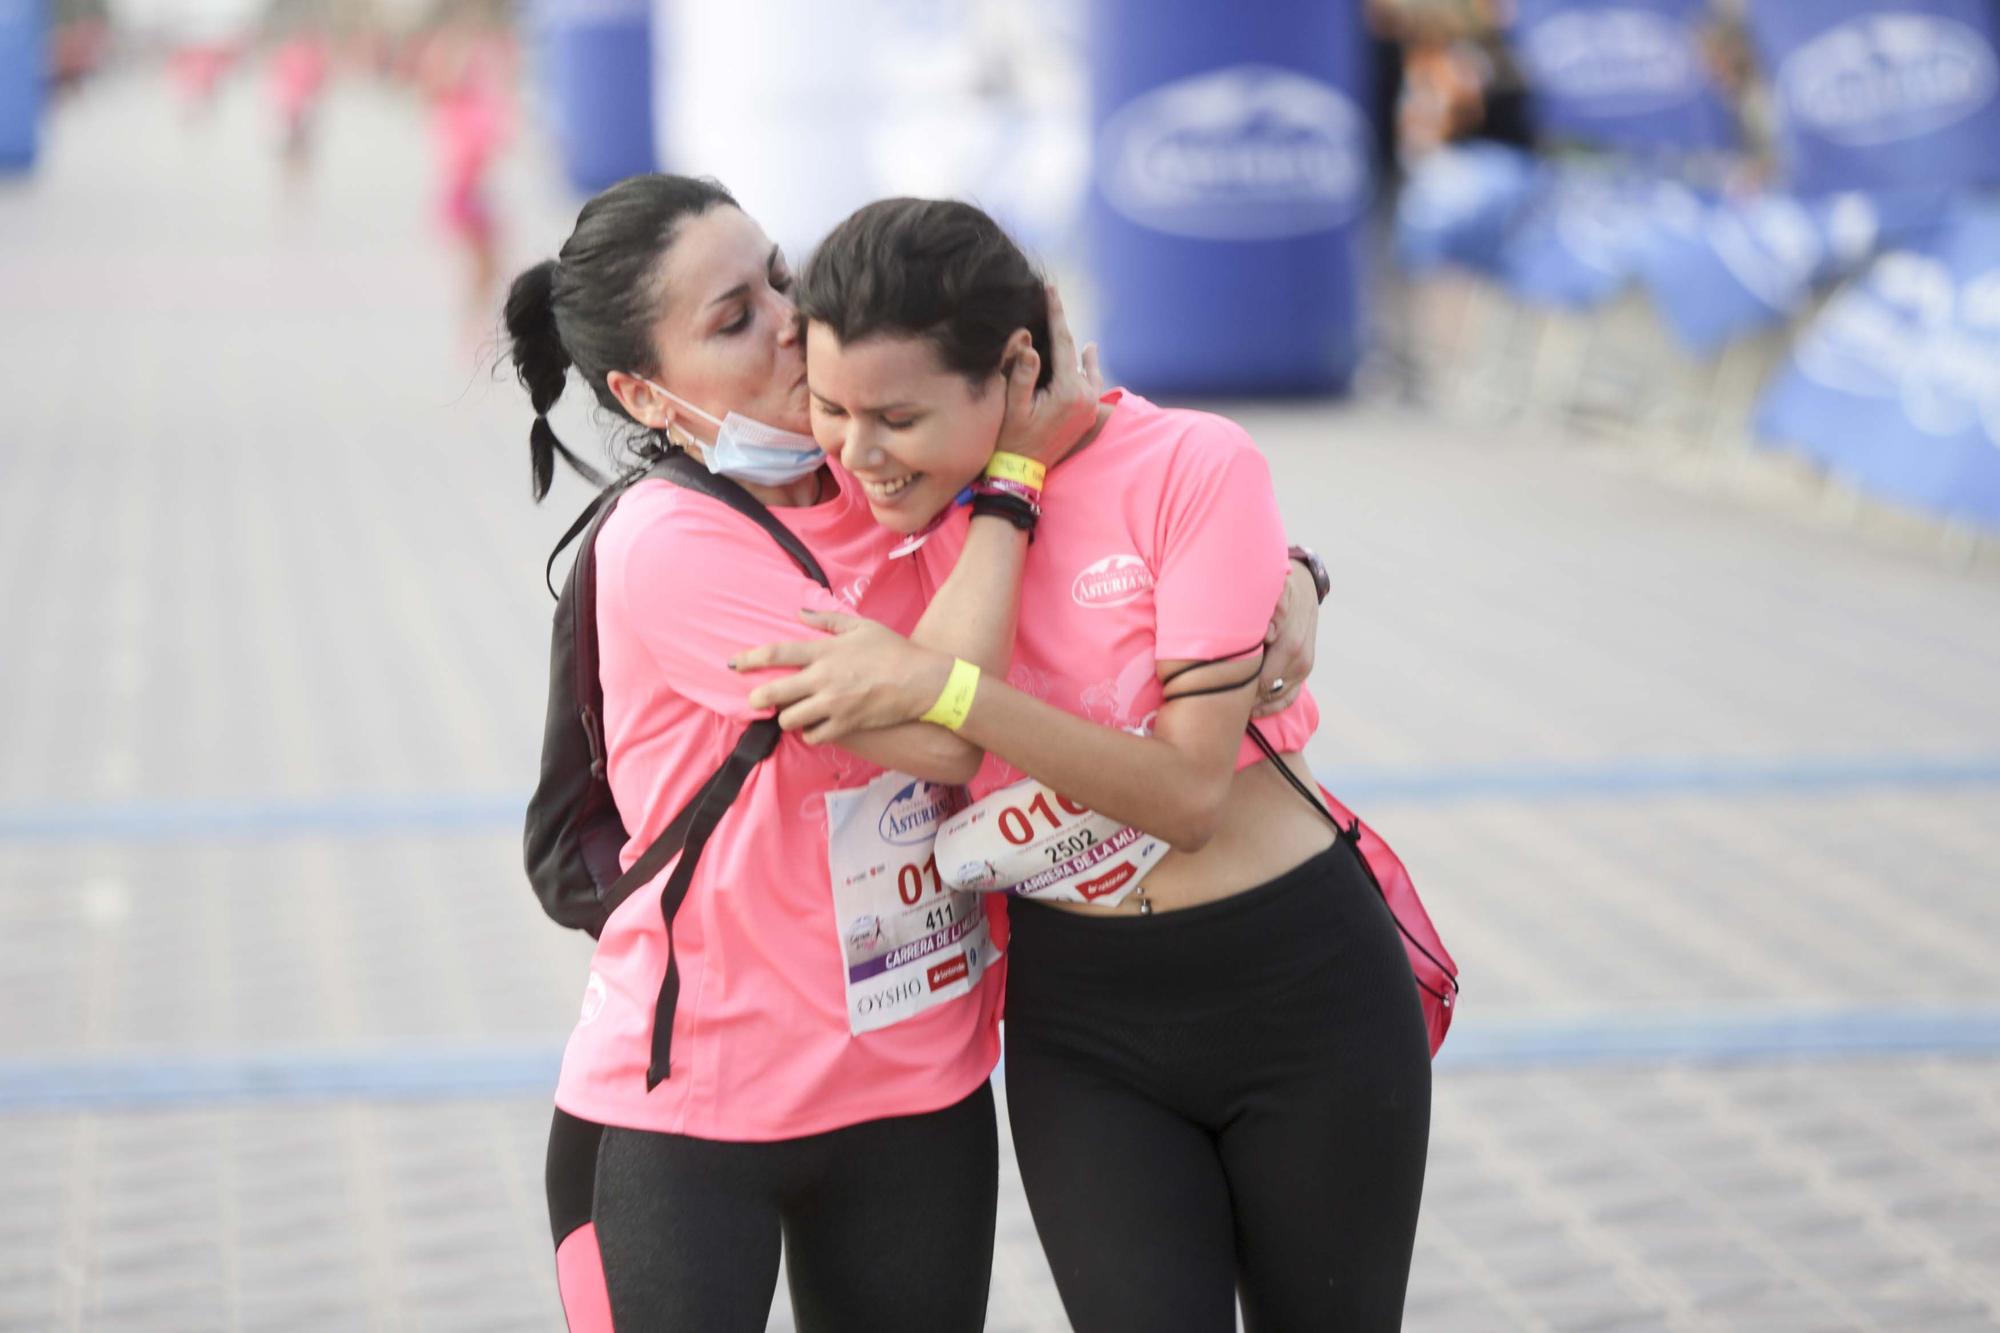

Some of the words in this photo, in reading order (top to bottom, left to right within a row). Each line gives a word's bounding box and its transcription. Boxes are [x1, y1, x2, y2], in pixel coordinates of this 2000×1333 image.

[1015, 861, 1074, 894] CARRERA
[1073, 853, 1093, 871] DE
[1093, 842, 1114, 861] LA
[1113, 827, 1142, 848] MU
[1044, 828, 1099, 864] 2502
[897, 852, 943, 906] 01
[926, 903, 954, 931] 411
[885, 937, 935, 969] CARRERA
[936, 931, 950, 949] DE
[857, 976, 922, 1016] OYSHO
